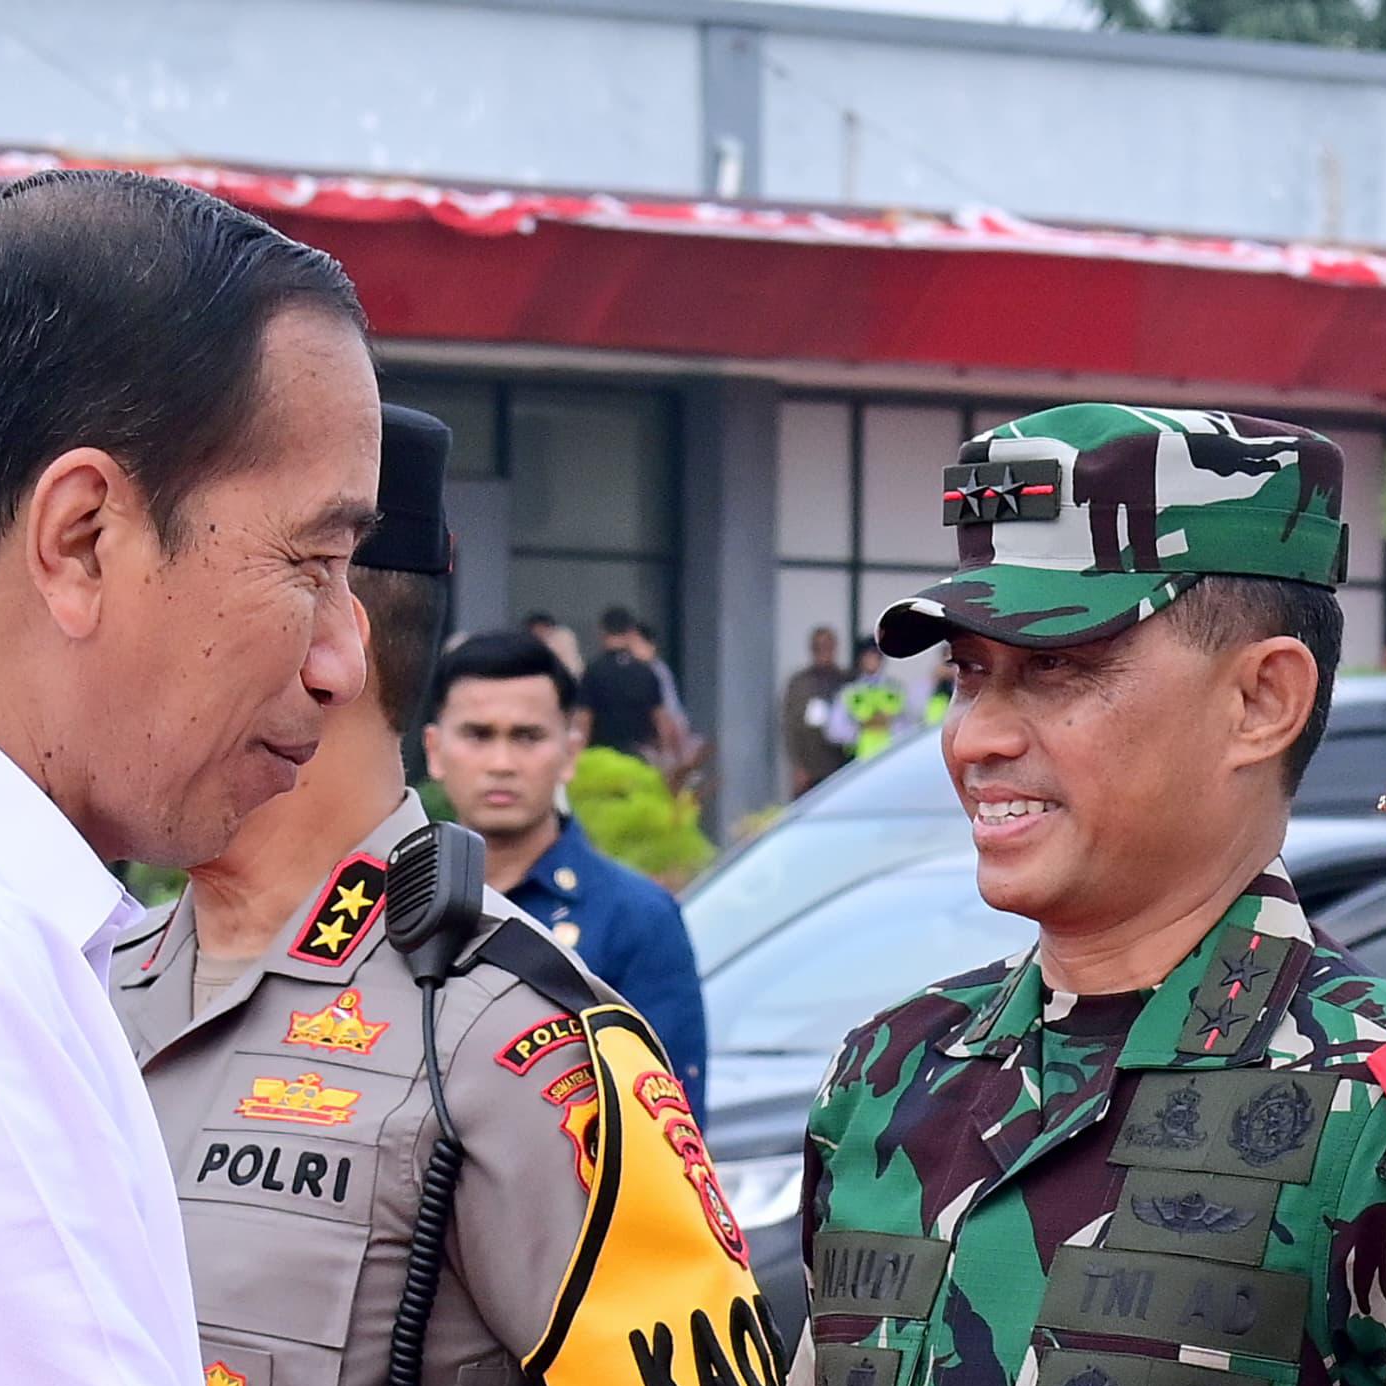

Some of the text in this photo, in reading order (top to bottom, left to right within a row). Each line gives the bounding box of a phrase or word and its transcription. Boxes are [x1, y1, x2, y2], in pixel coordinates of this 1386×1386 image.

[197, 1143, 351, 1202] POLRI
[1080, 1262, 1258, 1335] TNI AD
